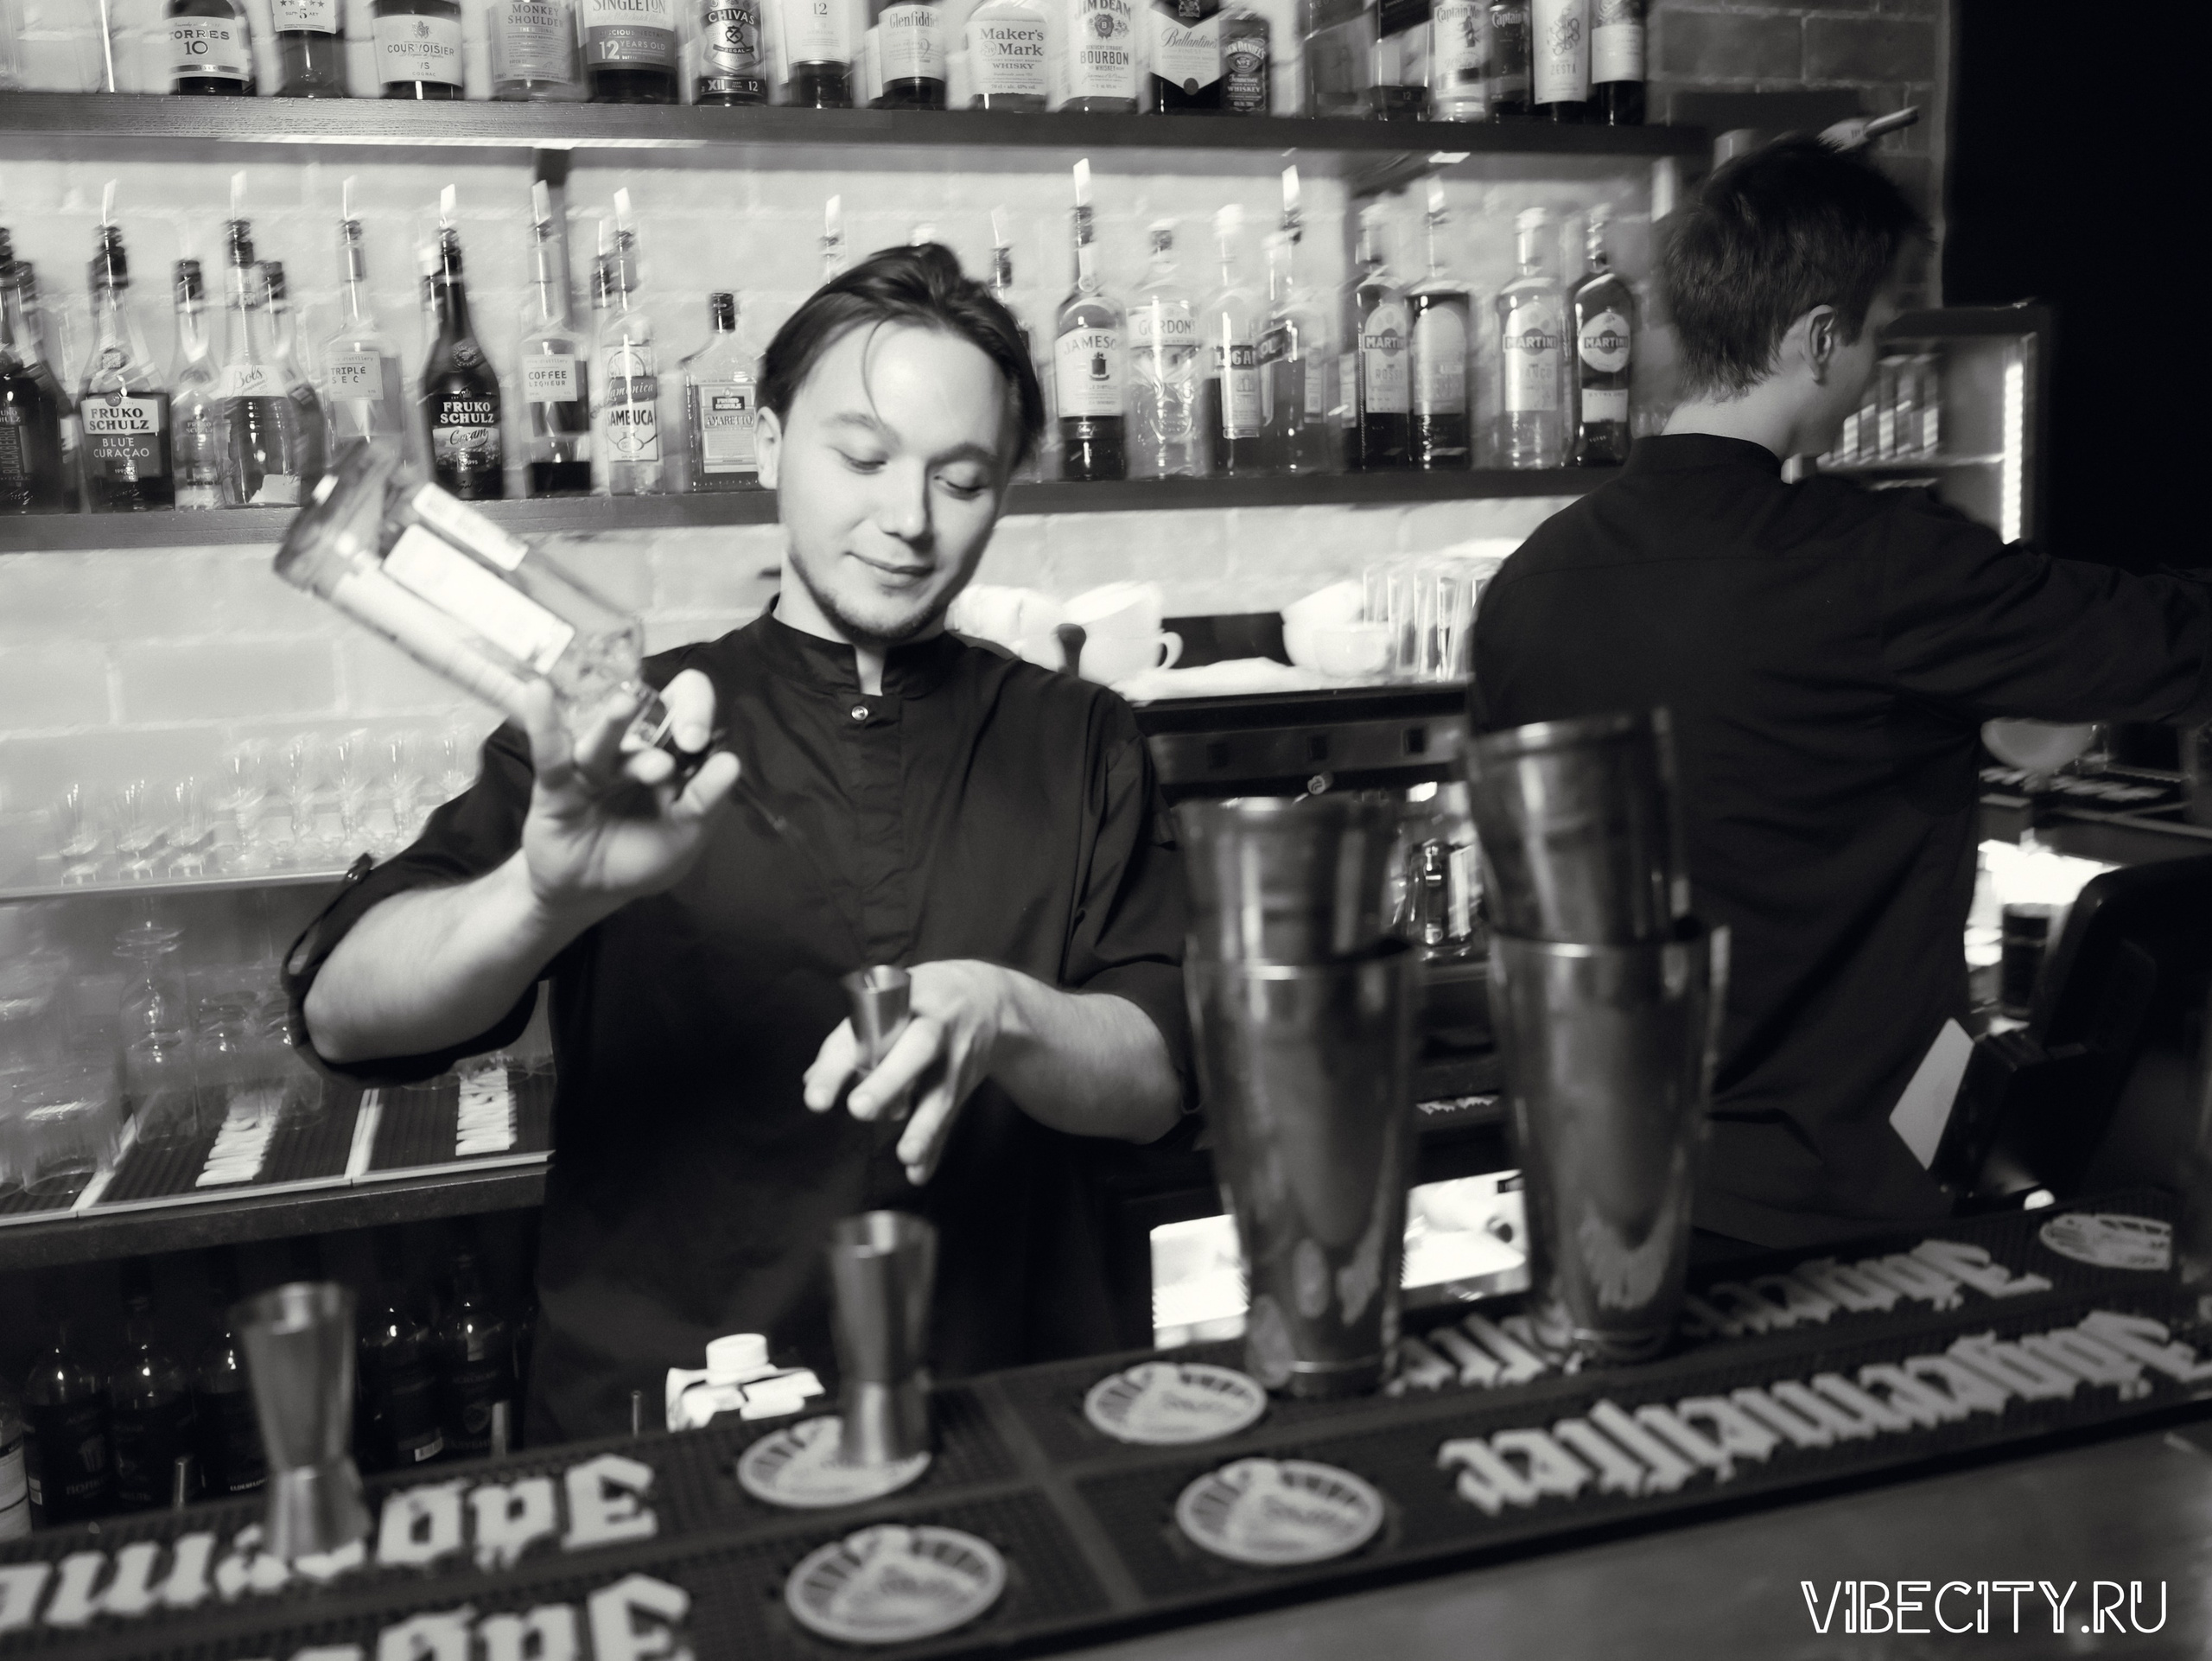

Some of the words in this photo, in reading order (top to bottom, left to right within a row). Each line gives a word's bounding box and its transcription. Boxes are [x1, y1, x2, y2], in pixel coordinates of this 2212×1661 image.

[299, 9, 308, 19] 5
[512, 4, 559, 16] MONKEY
[814, 3, 828, 15] 12
[1437, 6, 1467, 22] Captain
[708, 10, 755, 24] CHIVAS
[1492, 11, 1522, 29] Captain
[980, 28, 1044, 41] Maker's
[1160, 27, 1217, 48] Ballantine's
[184, 41, 208, 54] 10
[387, 44, 454, 56] COURVOISIER
[599, 40, 620, 60] 12
[651, 42, 665, 51] OLD
[998, 43, 1043, 56] Mark
[1080, 51, 1128, 66] BOURBON
[1550, 64, 1576, 74] ZESTA
[708, 80, 724, 91] XII
[748, 81, 759, 92] 12
[330, 366, 366, 375] TRIPLE
[528, 370, 568, 380] COFFEE
[225, 364, 263, 397] Bols
[91, 408, 143, 418] FRUKO
[443, 402, 491, 412] FRUKO
[440, 413, 494, 423] SCHULZ
[707, 416, 753, 426] AMARETTO
[89, 419, 149, 430] SCHULZ
[102, 437, 135, 448] BLUE
[449, 428, 488, 445] Cream
